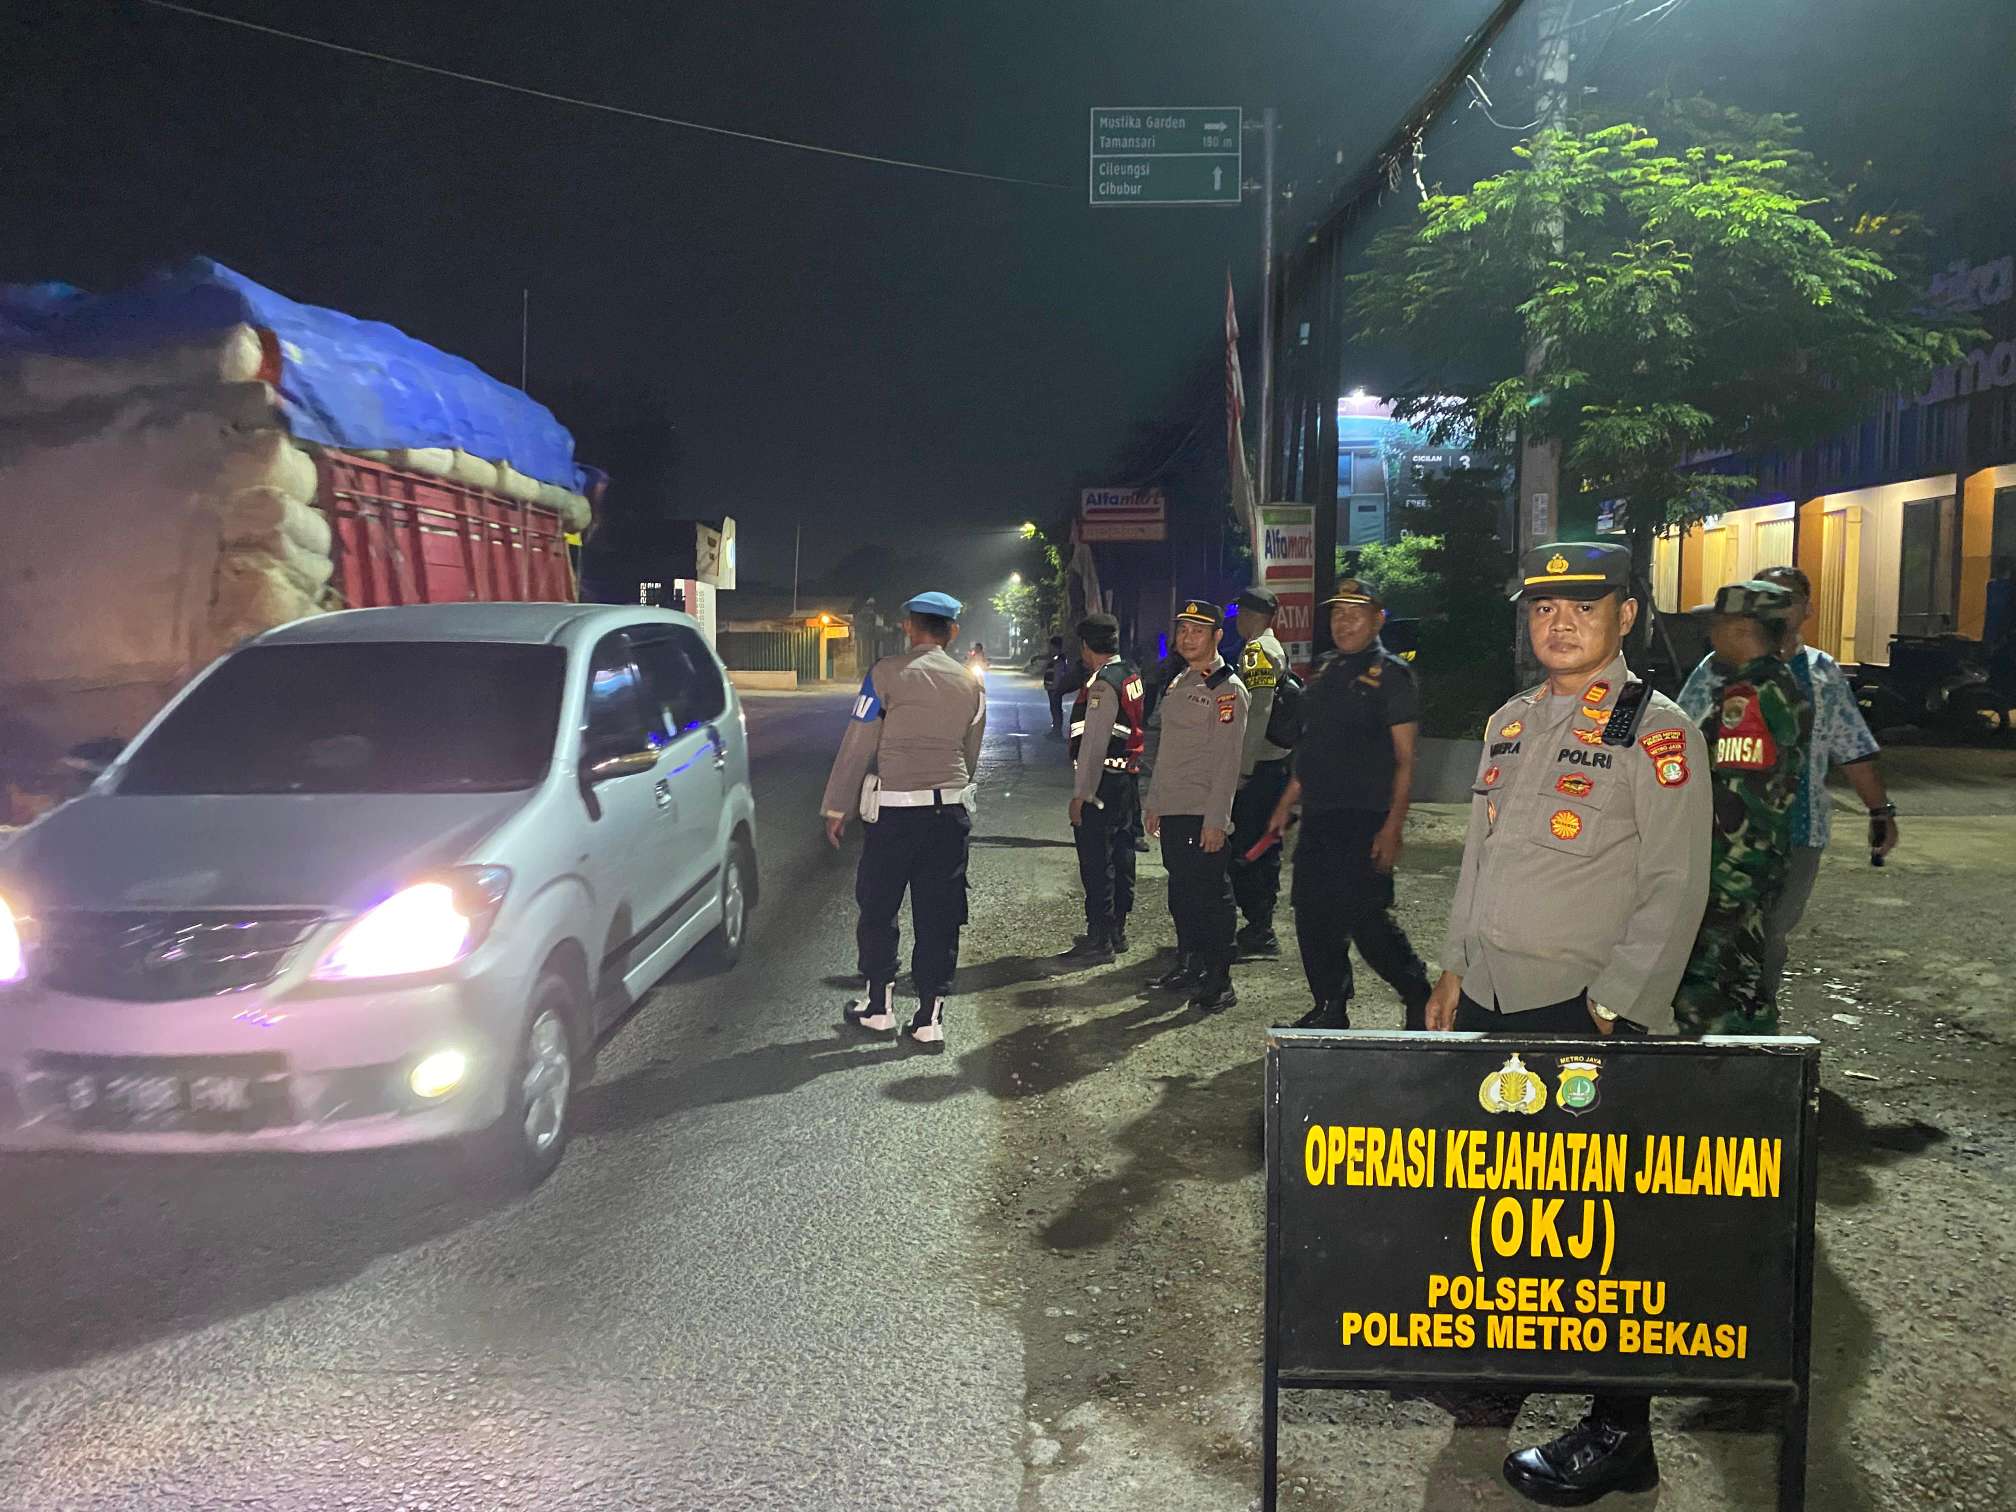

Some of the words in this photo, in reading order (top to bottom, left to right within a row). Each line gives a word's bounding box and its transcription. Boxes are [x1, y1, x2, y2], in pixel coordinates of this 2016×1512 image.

[1100, 116, 1141, 129] Mustika
[1146, 116, 1186, 129] Garden
[1100, 136, 1156, 148] Tamansari
[1099, 163, 1150, 178] Cileungsi
[1099, 182, 1142, 195] Cibubur
[1265, 529, 1312, 560] Alfamart
[1277, 605, 1309, 629] ATM
[1557, 748, 1612, 769] POLRI
[1560, 1055, 1584, 1064] METRO
[1586, 1056, 1601, 1065] JAYA
[1305, 1125, 1436, 1189] OPERASI
[1445, 1129, 1628, 1192] KEJAHATAN
[1635, 1135, 1782, 1198] JALANAN
[1470, 1196, 1616, 1276] (OKJ)
[1429, 1275, 1564, 1313] POLSEK
[1575, 1279, 1666, 1315] SETU
[1342, 1312, 1476, 1349] POLRES
[1487, 1315, 1608, 1352] METRO
[1619, 1320, 1748, 1360] BEKASI
